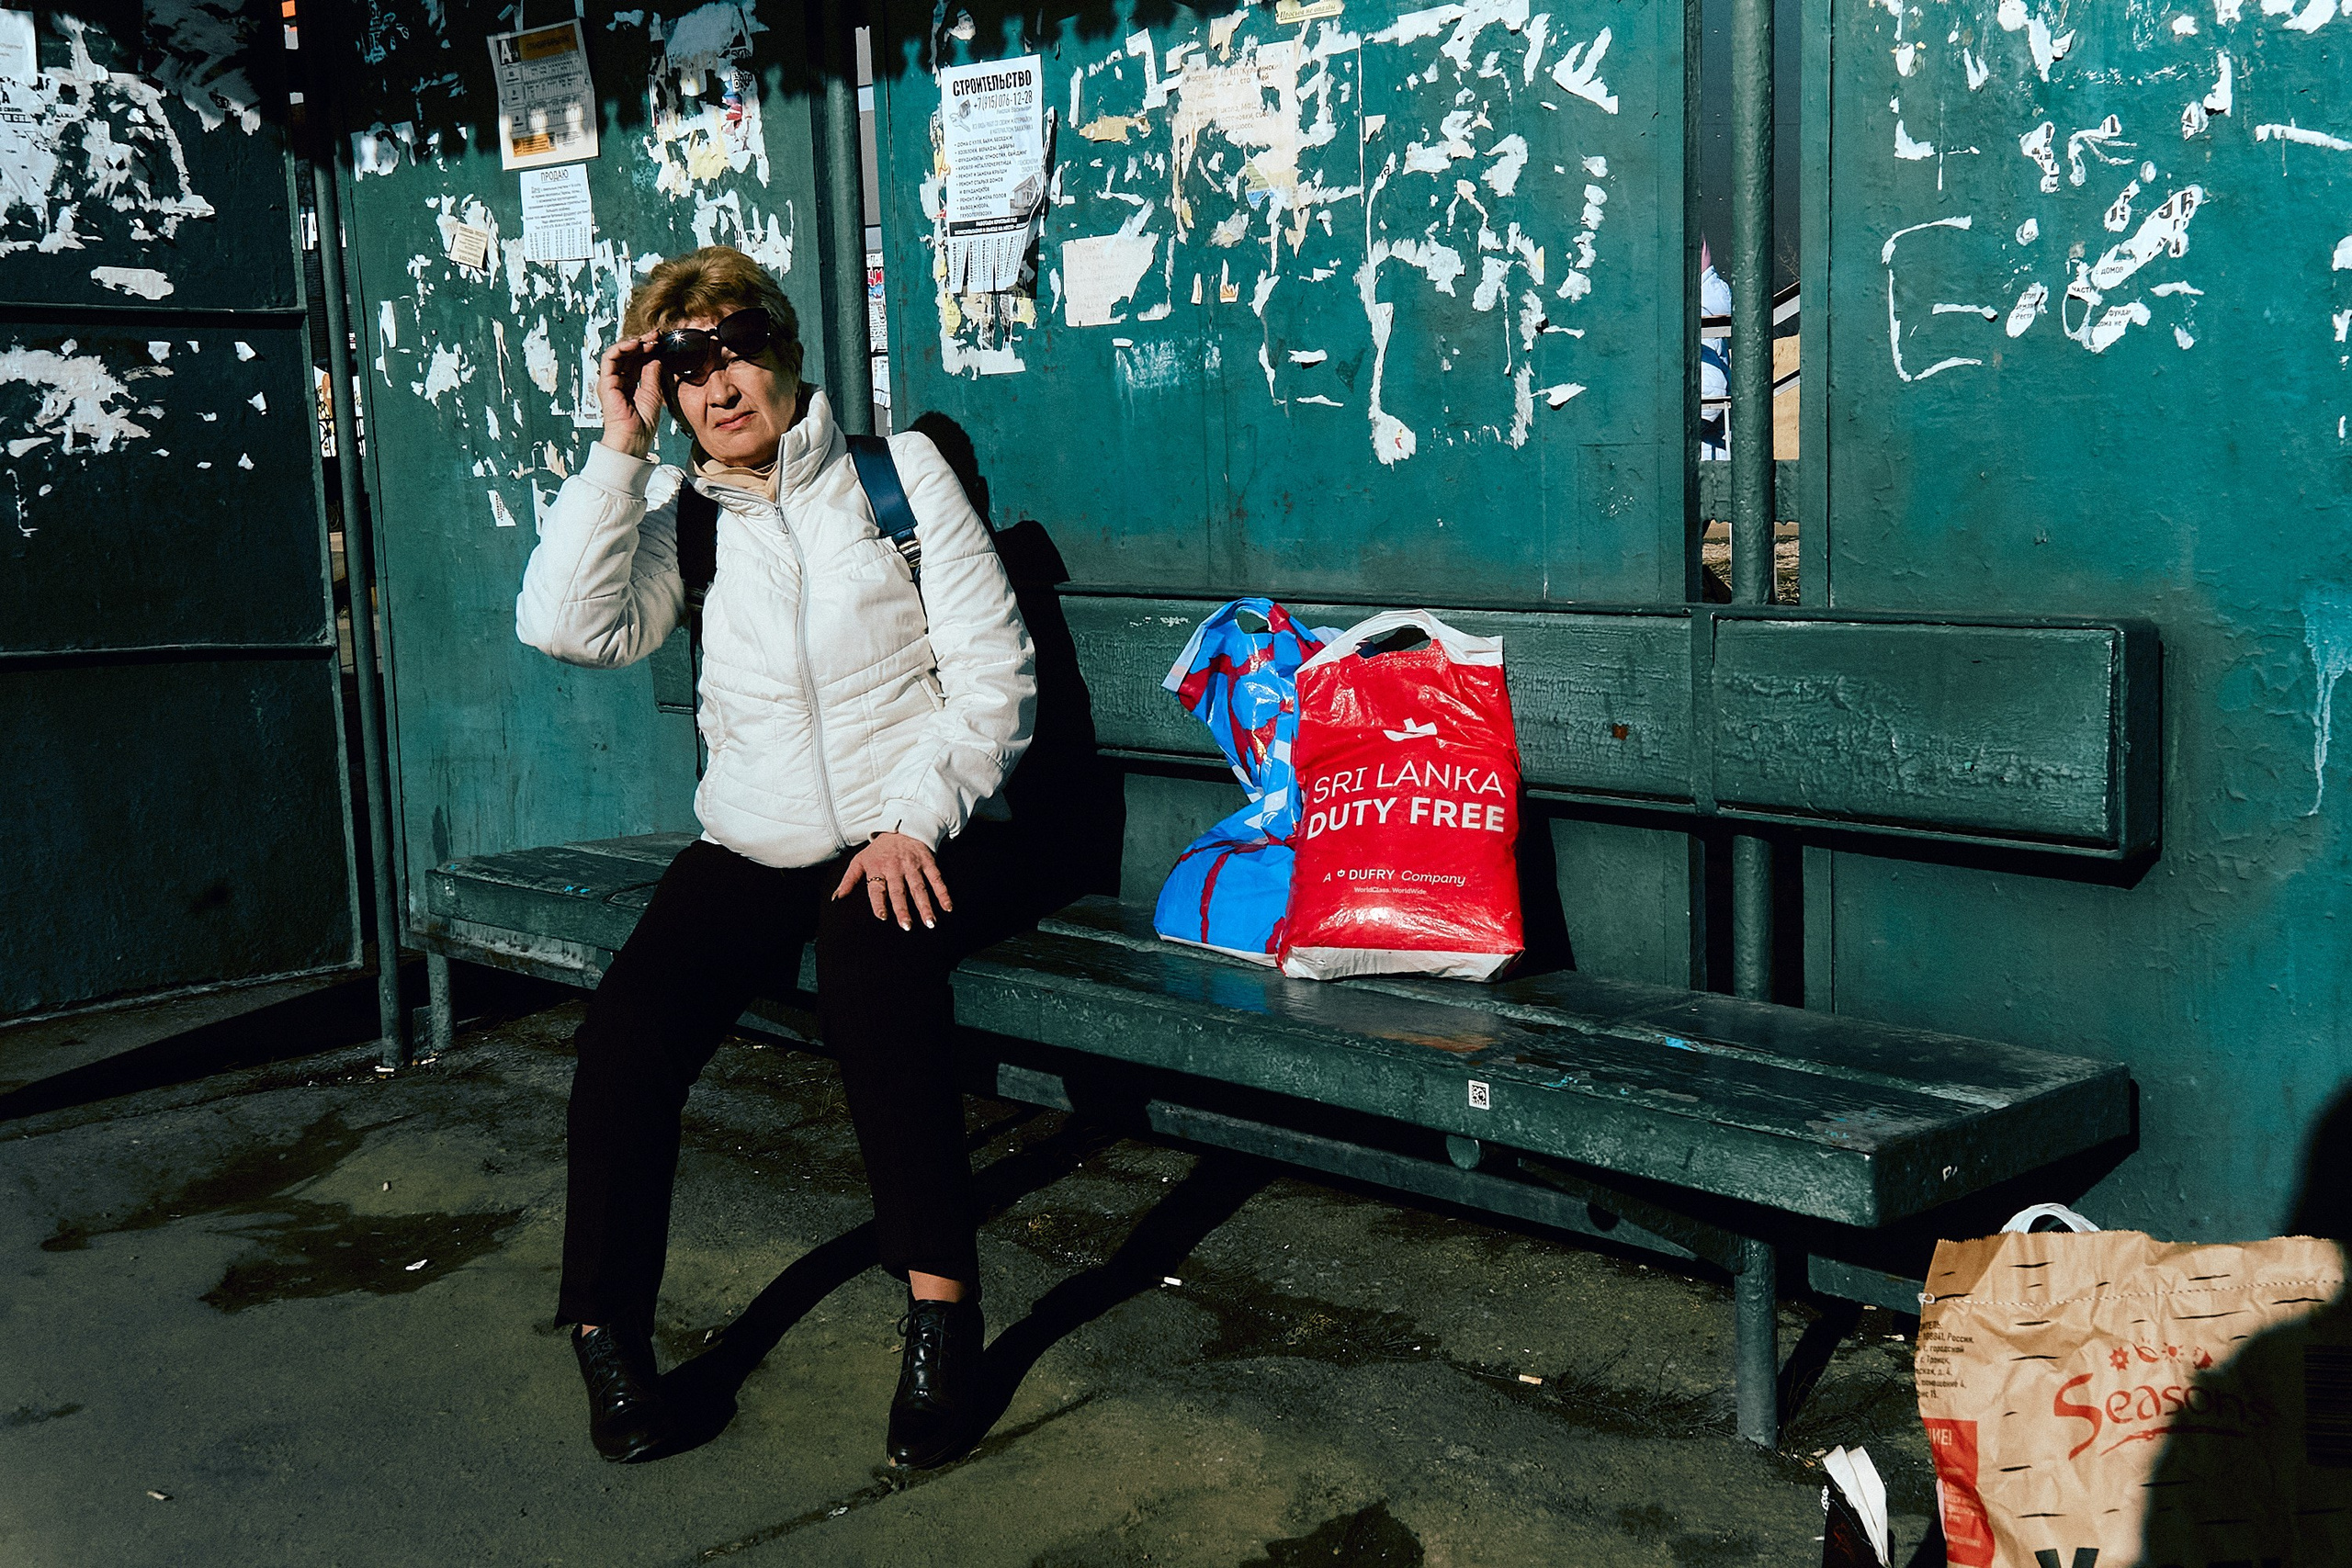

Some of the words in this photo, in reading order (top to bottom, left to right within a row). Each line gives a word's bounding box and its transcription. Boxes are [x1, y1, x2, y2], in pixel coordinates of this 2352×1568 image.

[953, 70, 1032, 96] СТРОИТЕЛЬСТВО
[540, 169, 569, 182] ПРОДАЮ
[1313, 766, 1368, 804] SRI
[1376, 761, 1506, 798] LANKA
[1306, 797, 1397, 840] DUTY
[1410, 796, 1505, 833] FREE
[1323, 873, 1331, 882] A
[1349, 869, 1395, 880] DUFRY
[1401, 870, 1465, 887] Company
[2054, 1372, 2277, 1461] Seasons
